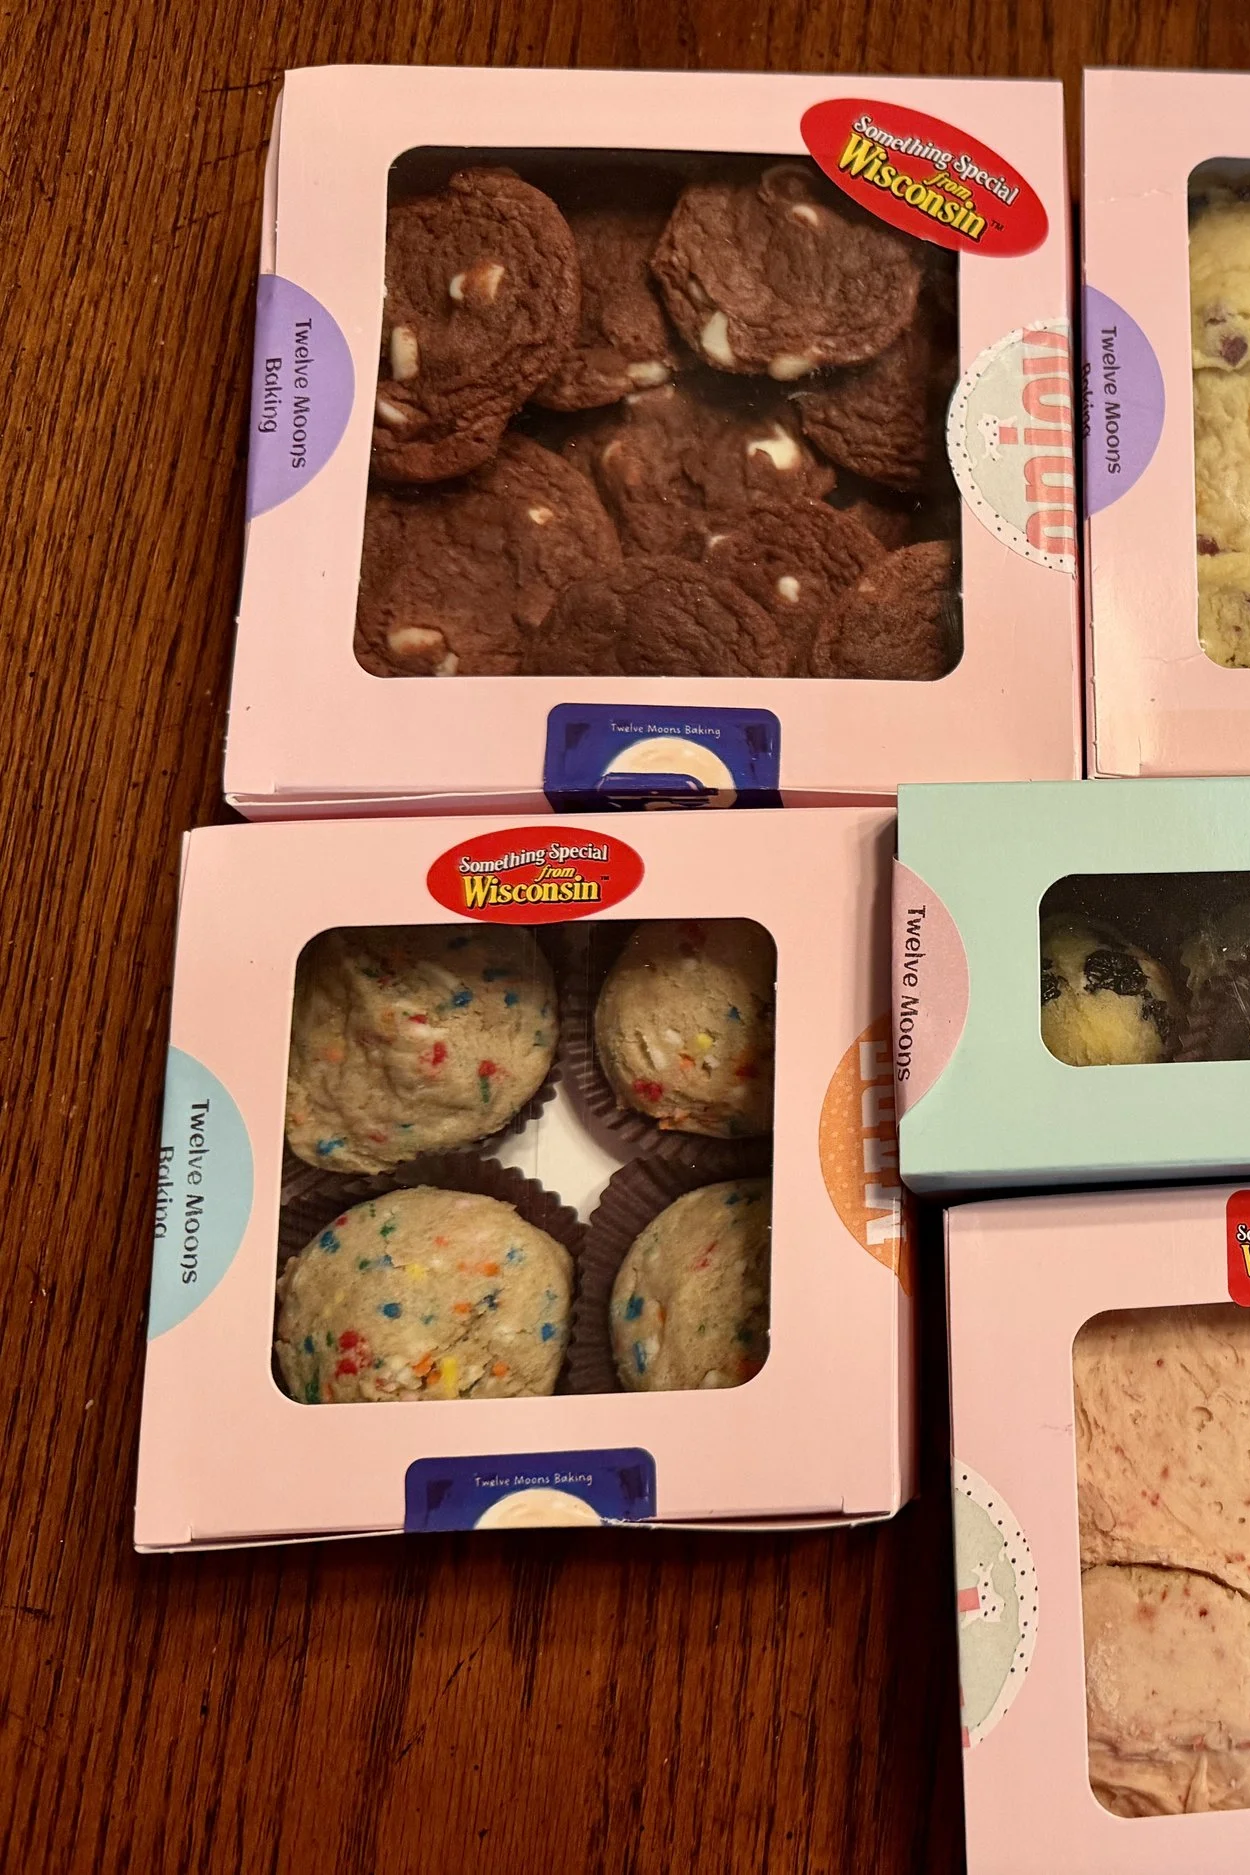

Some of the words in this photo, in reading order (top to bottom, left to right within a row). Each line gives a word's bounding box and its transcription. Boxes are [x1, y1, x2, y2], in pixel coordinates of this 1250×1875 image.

[839, 131, 986, 240] Wisconsin
[853, 115, 953, 169] Something
[953, 154, 1019, 206] Special
[923, 170, 973, 200] from
[294, 318, 314, 389] Twelve
[1101, 325, 1121, 396] Twelve
[258, 357, 283, 433] Baking
[290, 396, 311, 469] Moons
[1104, 401, 1121, 475] Moons
[611, 722, 644, 734] Twelve
[647, 724, 681, 735] Moons
[685, 724, 721, 739] Baking
[458, 850, 546, 874] Something
[548, 842, 608, 864] Special
[462, 874, 601, 909] Wisconsin
[534, 864, 576, 882] from
[903, 905, 926, 987] Twelve
[897, 995, 919, 1081] Moons
[187, 1098, 210, 1186] Twelve
[180, 1193, 205, 1285] Moons
[474, 1476, 509, 1487] Twelve
[514, 1475, 550, 1486] Moons
[554, 1472, 592, 1486] Baking
